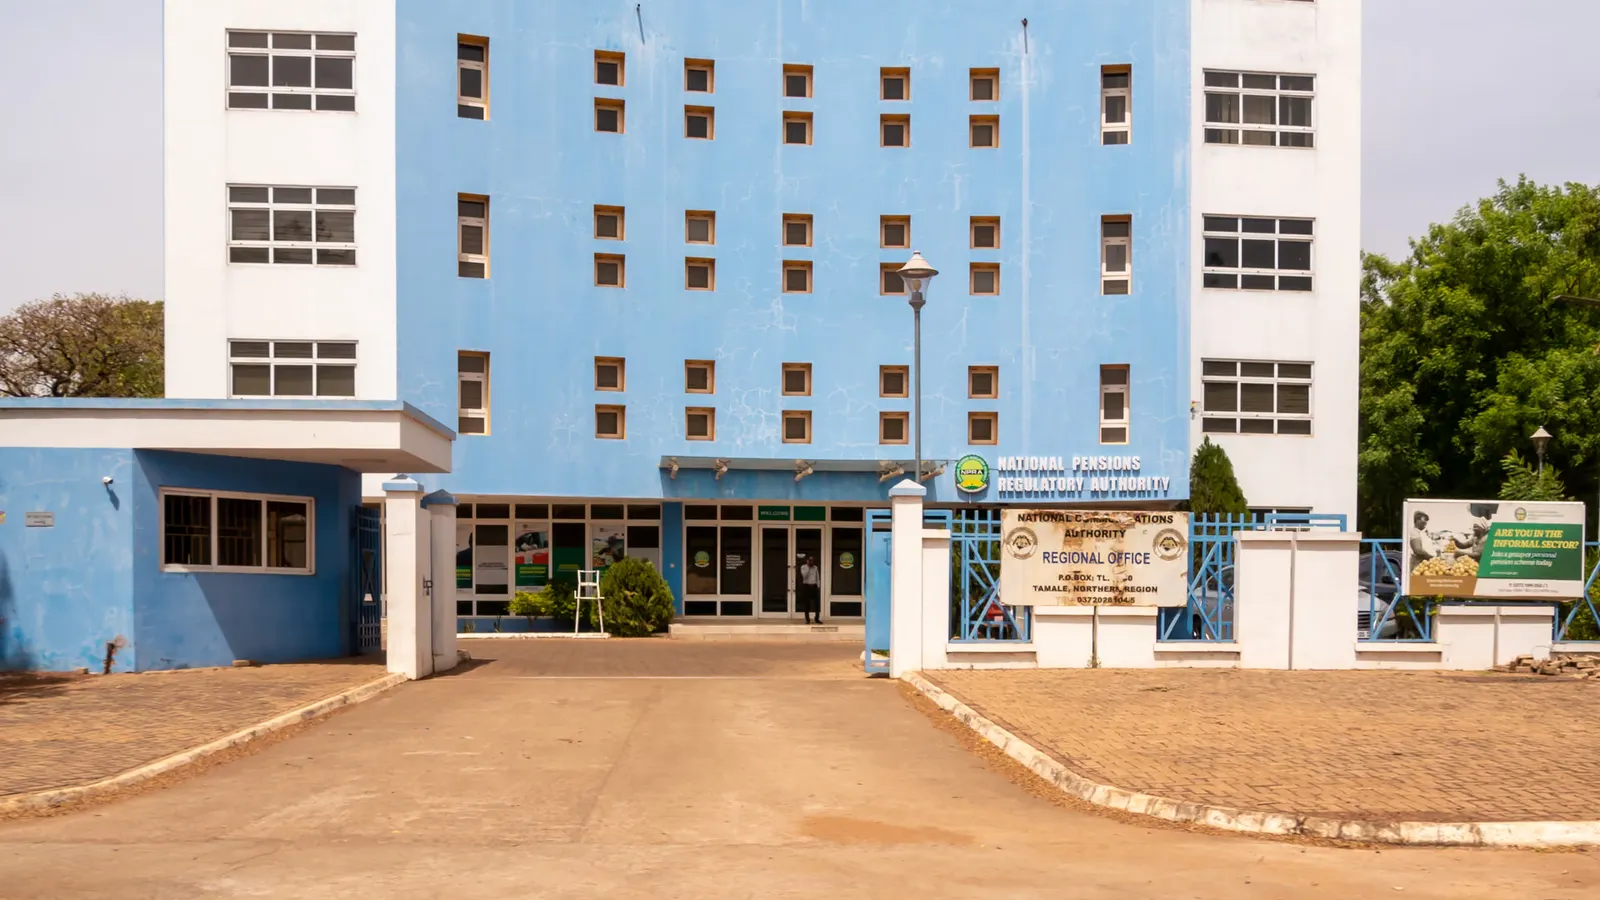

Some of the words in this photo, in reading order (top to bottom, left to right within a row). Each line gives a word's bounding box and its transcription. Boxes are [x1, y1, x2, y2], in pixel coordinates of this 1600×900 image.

[997, 456, 1064, 471] NATIONAL
[1072, 456, 1141, 471] PENSIONS
[997, 477, 1084, 492] REGULATORY
[1090, 476, 1170, 492] AUTHORITY
[1017, 513, 1072, 523] NATIONAL
[1065, 529, 1126, 538] AUTHORITY
[1494, 529, 1513, 537] ARE
[1515, 529, 1533, 538] YOU
[1534, 530, 1544, 538] IN
[1545, 530, 1563, 538] THE
[1493, 539, 1540, 549] INFORMAL
[1541, 540, 1579, 549] SECTOR?
[1042, 551, 1105, 564] REGIONAL
[1107, 552, 1151, 565] OFFICE
[1033, 585, 1070, 593] TAMALE,
[1124, 585, 1158, 593] REGION
